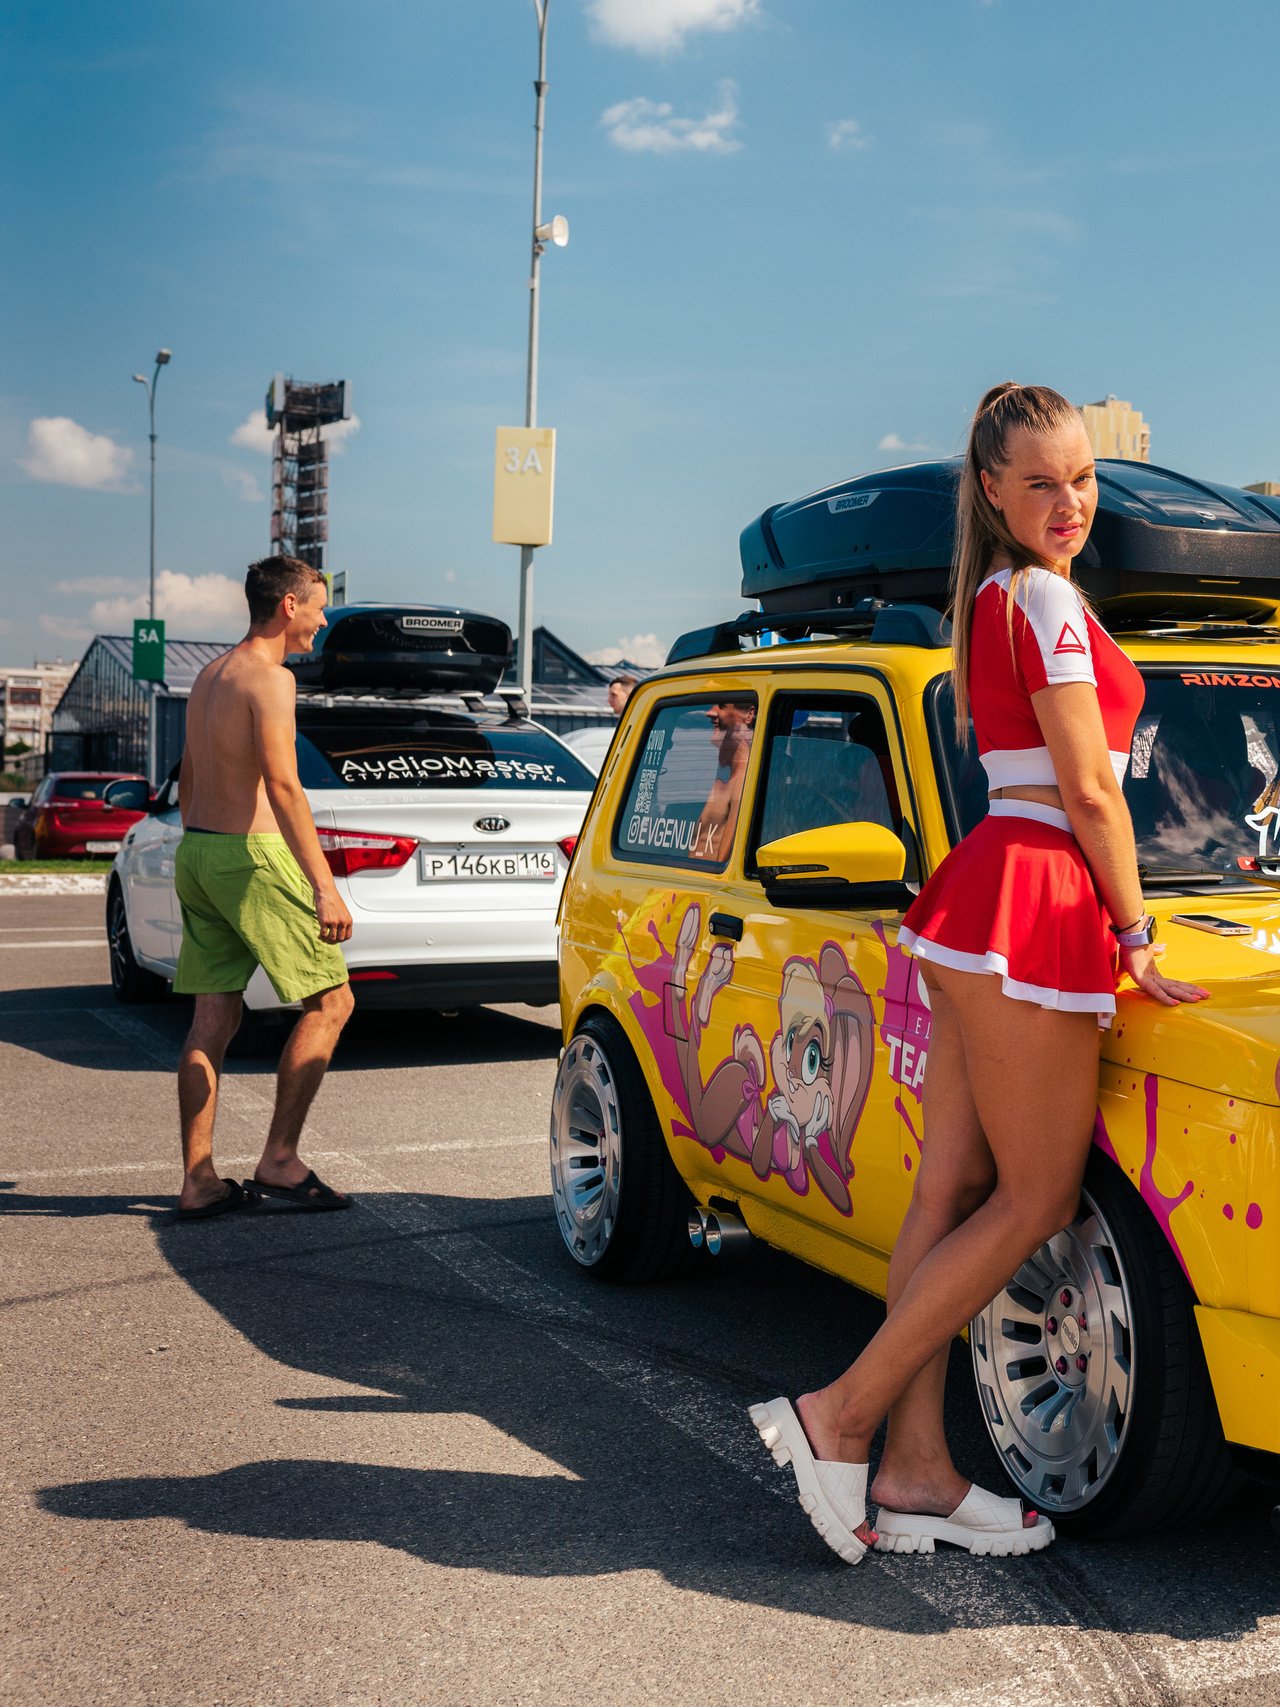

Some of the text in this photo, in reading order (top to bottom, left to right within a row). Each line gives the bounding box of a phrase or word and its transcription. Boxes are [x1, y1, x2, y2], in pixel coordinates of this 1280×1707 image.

[504, 446, 543, 474] 3A
[834, 495, 870, 511] BROOMER
[405, 618, 462, 628] BROOMER
[138, 628, 160, 644] 5A
[341, 755, 556, 776] AudioMaster
[344, 770, 567, 784] СТУДИЯ АВТОЗВУКА
[480, 818, 506, 830] KIA
[520, 852, 551, 869] 116
